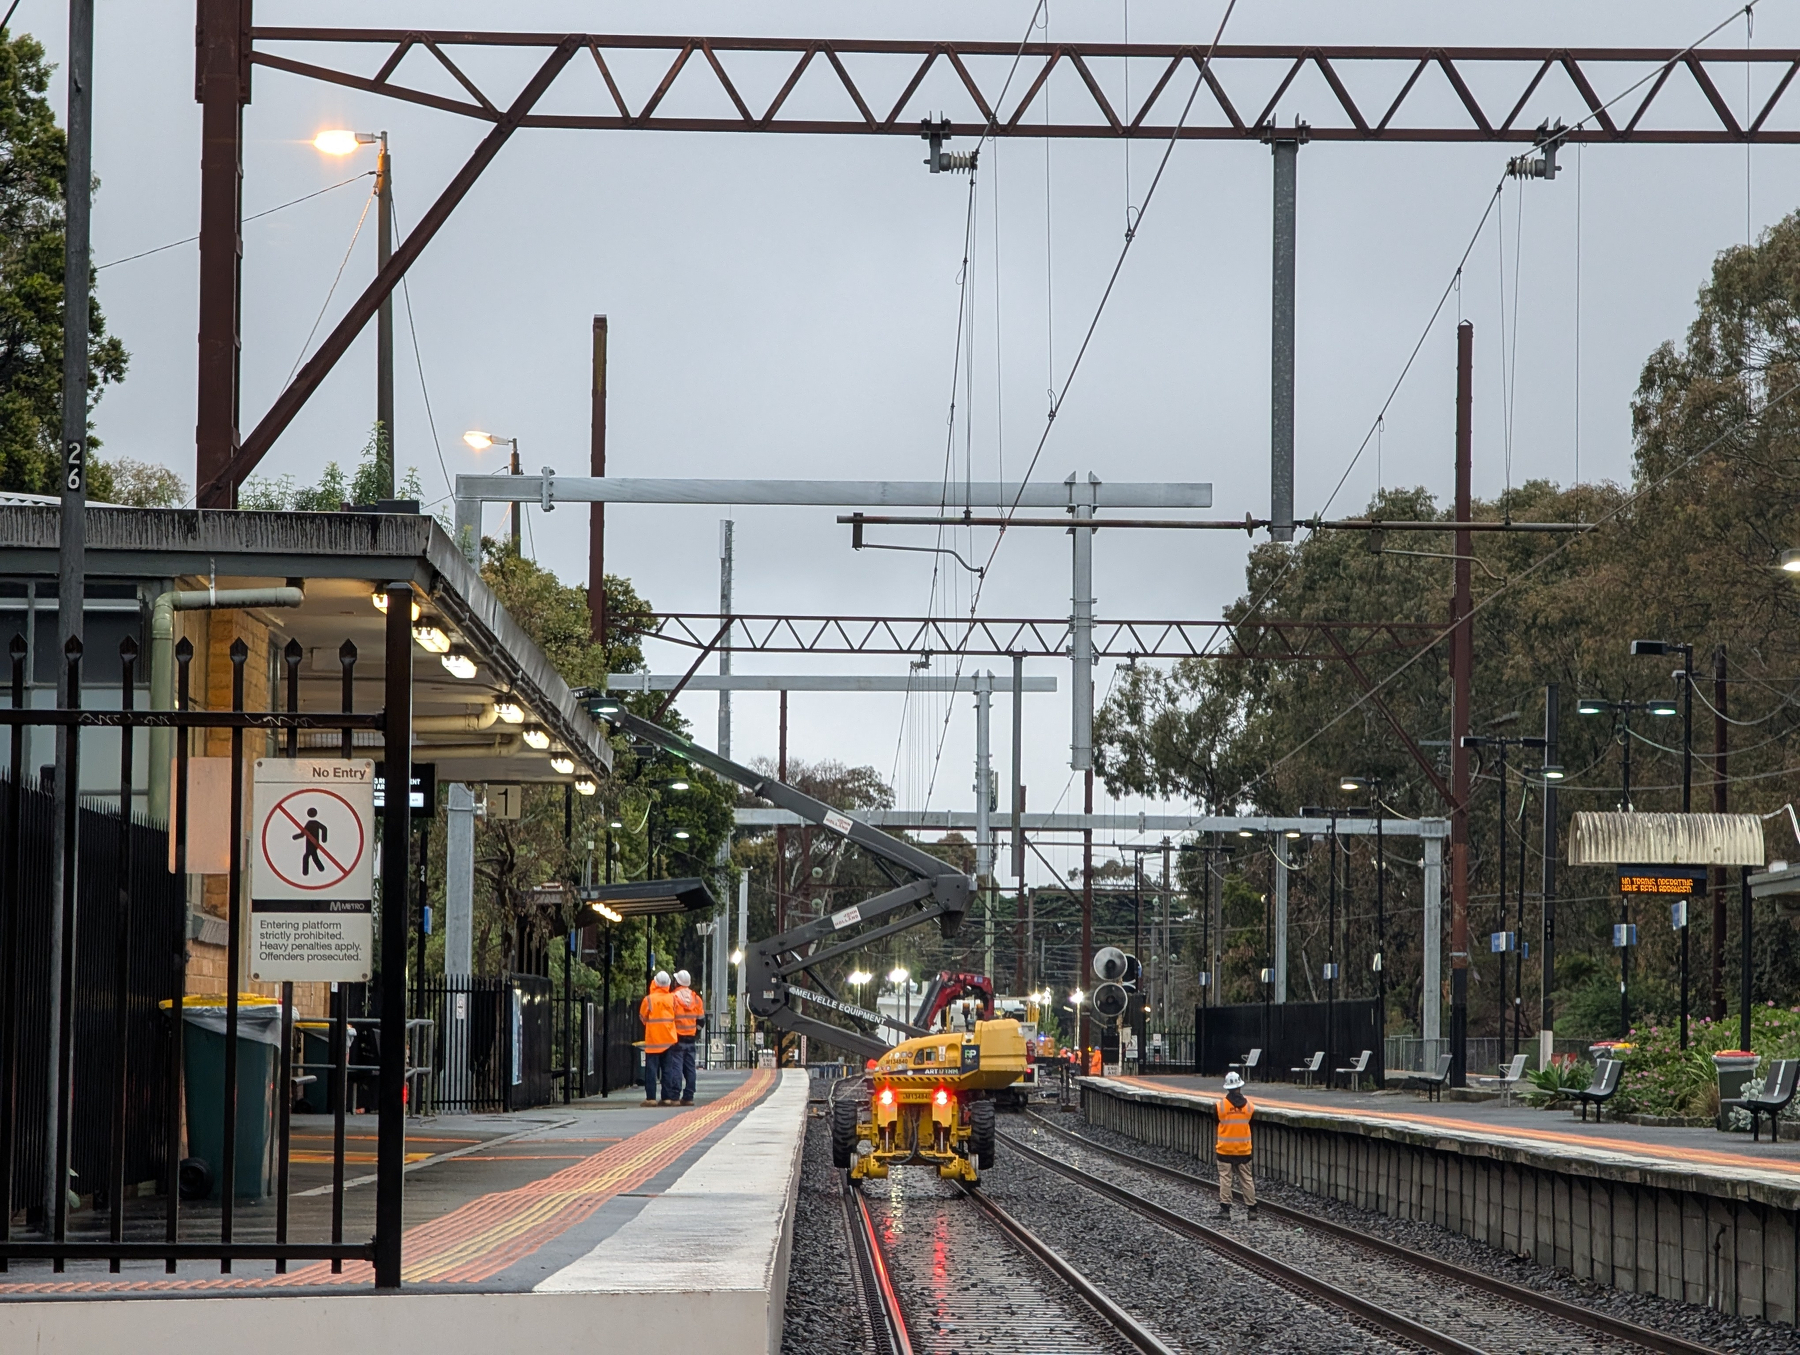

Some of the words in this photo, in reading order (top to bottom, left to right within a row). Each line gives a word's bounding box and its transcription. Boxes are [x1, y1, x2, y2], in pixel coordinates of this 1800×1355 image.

[68, 442, 81, 490] 26
[312, 767, 330, 778] No
[333, 767, 367, 780] Entry
[497, 787, 509, 816] 1
[260, 920, 299, 931] Entering
[302, 919, 342, 931] platform
[260, 931, 291, 941] strictly
[294, 930, 345, 941] prohibited.
[260, 941, 288, 952] Heavy
[291, 941, 332, 952] penalties
[334, 942, 362, 952] apply.
[259, 951, 305, 962] Offenders
[307, 951, 362, 963] prosecuted.
[796, 988, 837, 1009] MELVELLE
[838, 1003, 887, 1025] EQUIPMENT
